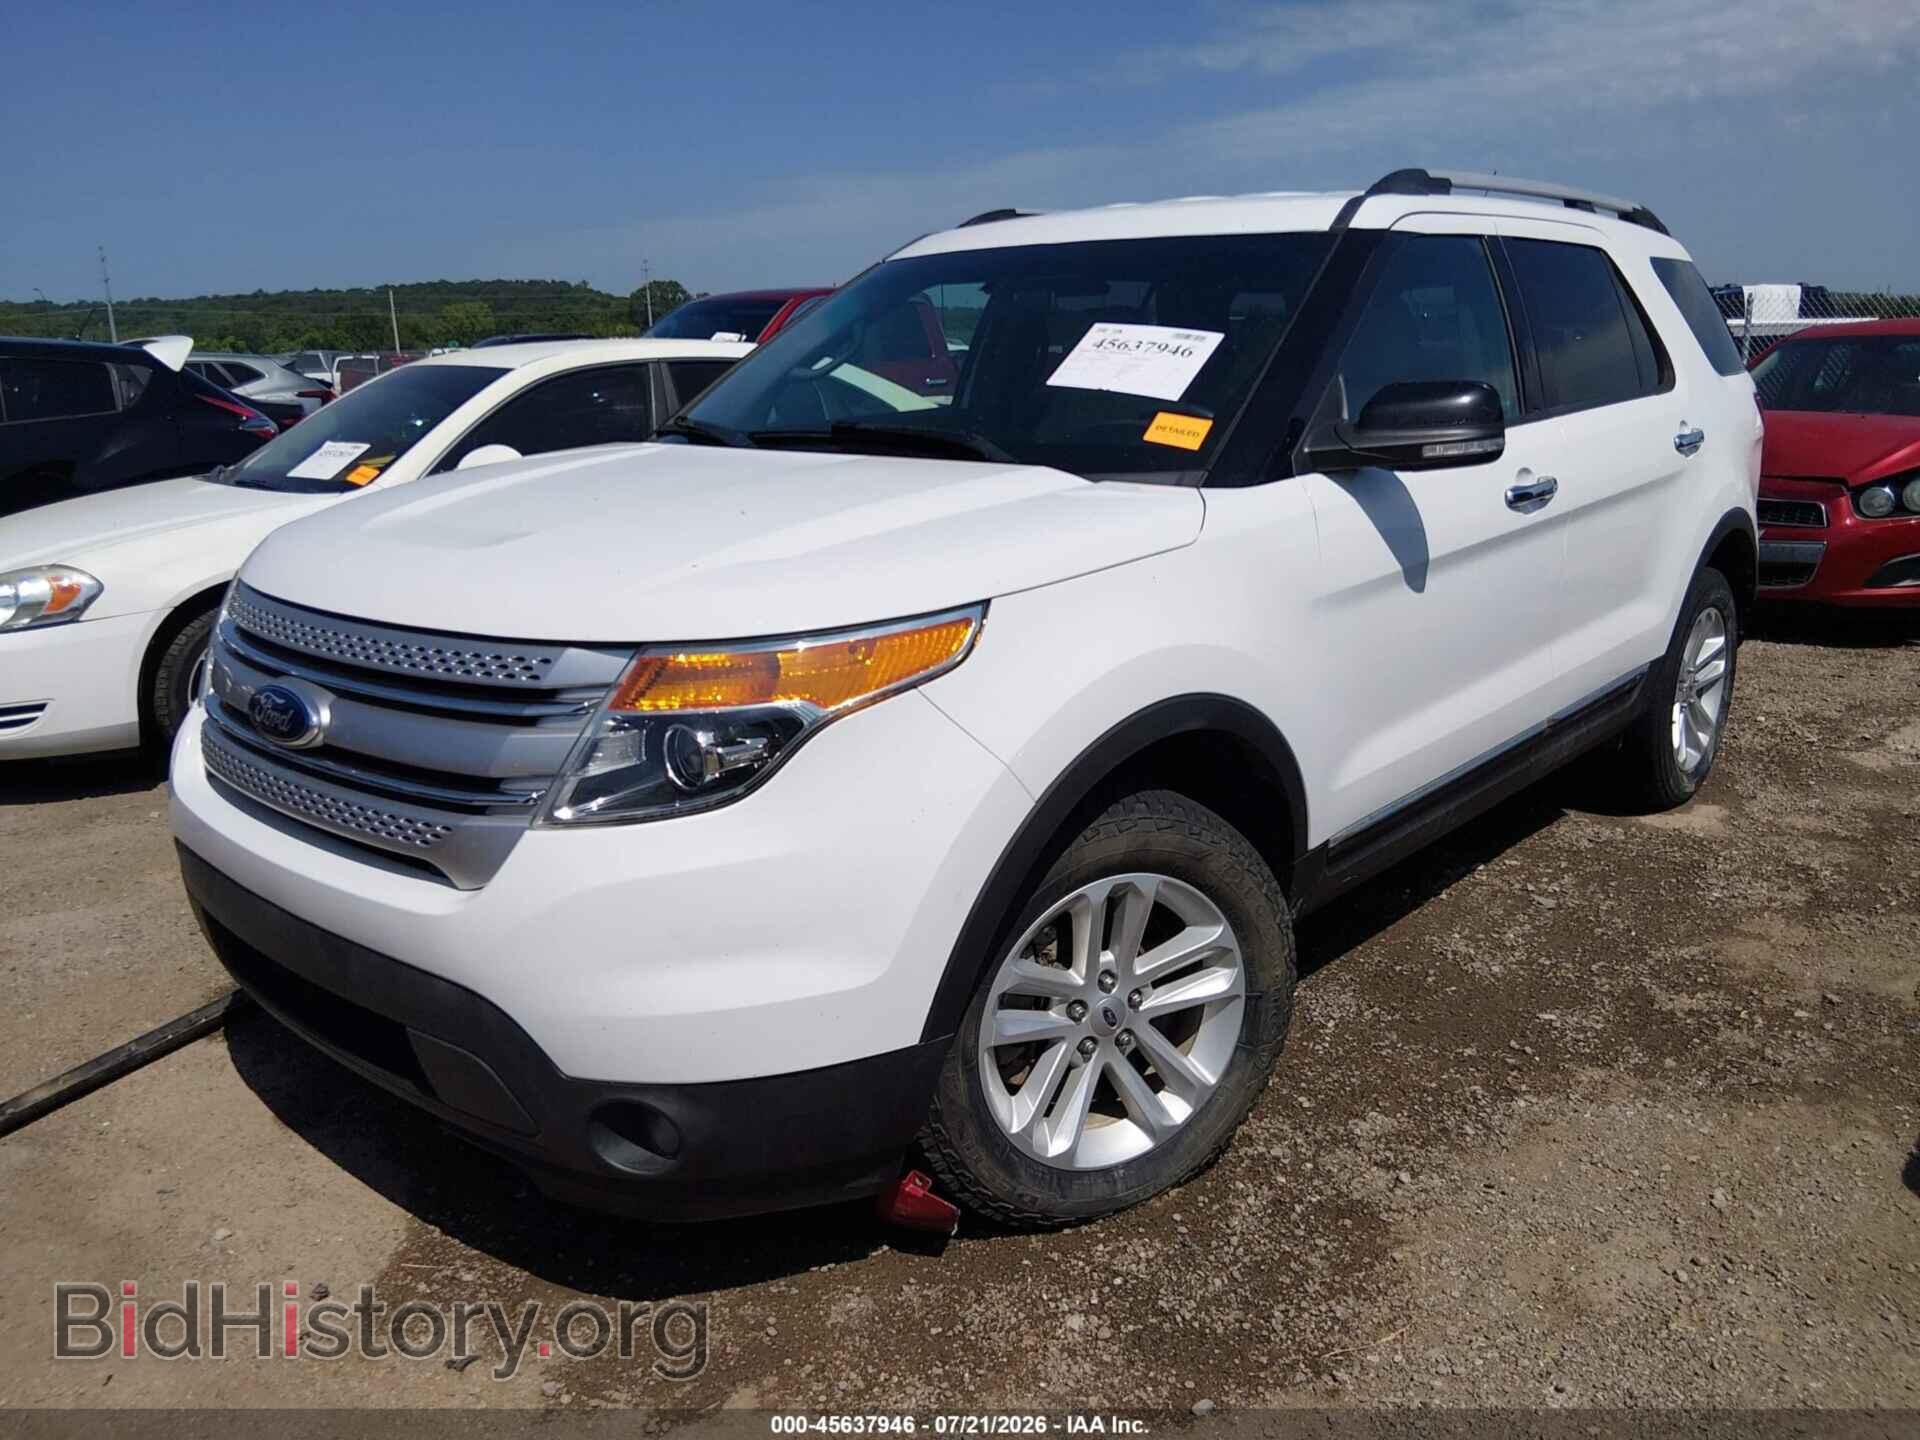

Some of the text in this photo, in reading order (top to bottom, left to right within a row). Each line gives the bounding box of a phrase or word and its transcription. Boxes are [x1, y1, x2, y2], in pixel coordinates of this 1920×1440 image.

[1093, 338, 1194, 358] 45637946
[1155, 424, 1200, 438] DETAILED
[255, 692, 295, 732] Ford
